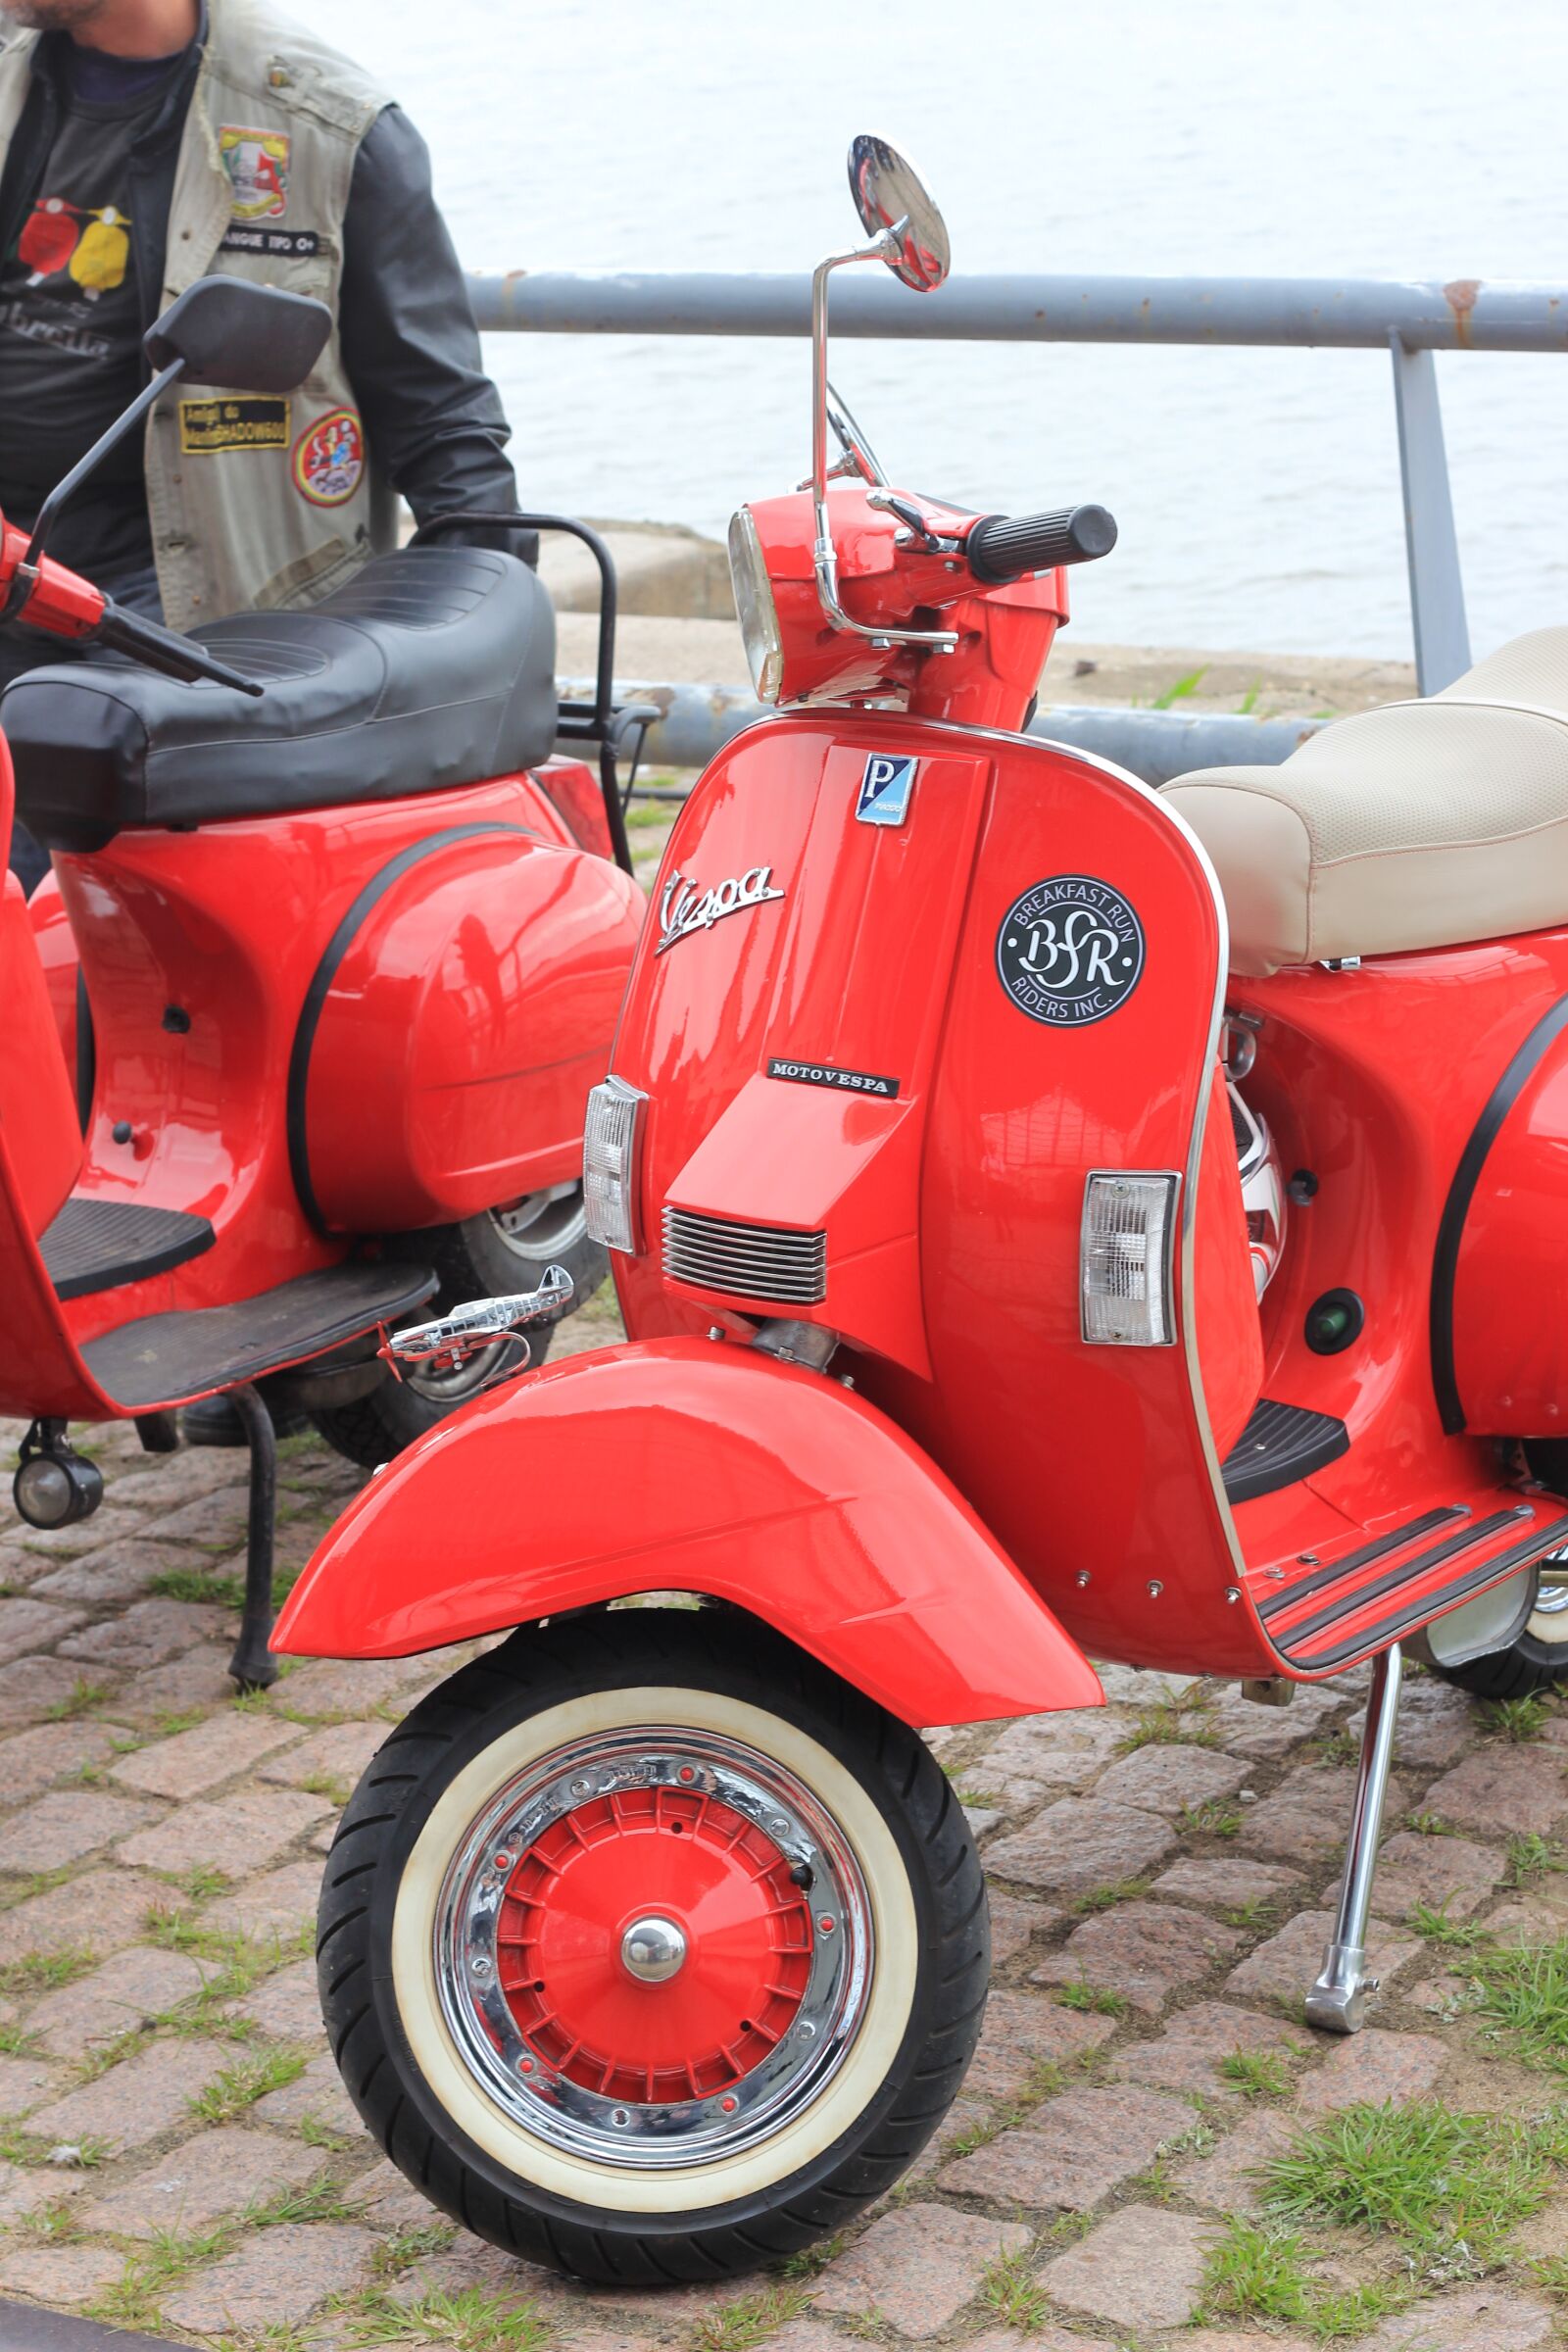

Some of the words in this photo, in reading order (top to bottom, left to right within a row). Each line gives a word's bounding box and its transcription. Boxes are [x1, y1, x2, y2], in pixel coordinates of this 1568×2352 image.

[224, 231, 263, 248] ANGUE
[269, 235, 292, 250] TIPO
[863, 760, 895, 799] P
[654, 866, 785, 956] Vespa
[1013, 884, 1111, 926] BREAKFAST
[1106, 904, 1136, 943] RUN
[1011, 976, 1068, 1018] RIDERS
[1074, 993, 1113, 1017] INC.
[772, 1062, 889, 1094] MOTOVESPA
